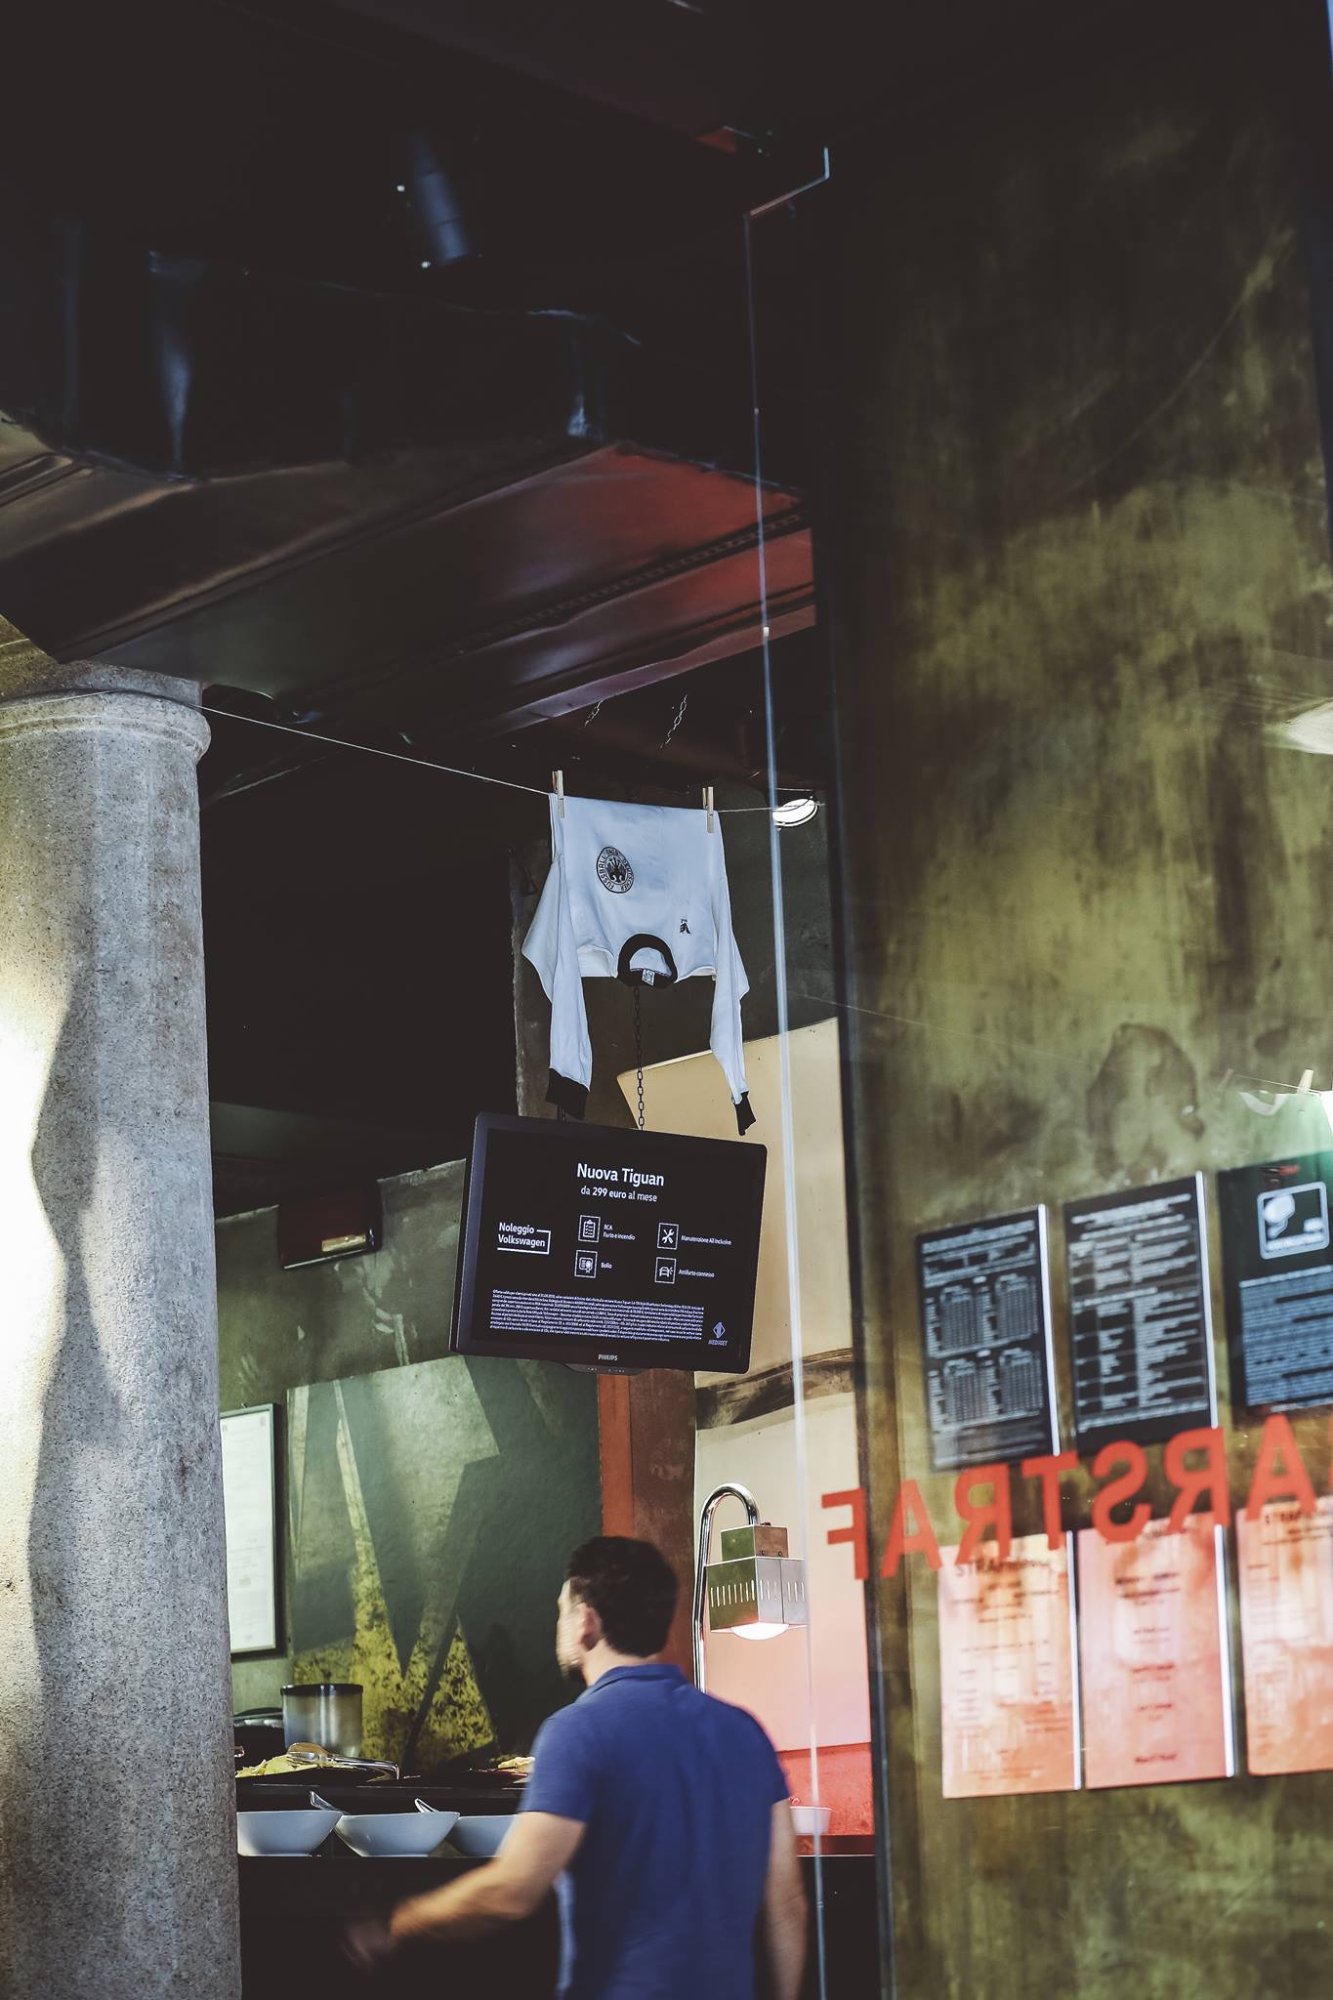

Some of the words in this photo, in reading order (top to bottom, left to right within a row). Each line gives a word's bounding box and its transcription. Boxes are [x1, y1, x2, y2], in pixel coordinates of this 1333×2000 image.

[576, 1163, 618, 1182] Nuova
[621, 1167, 665, 1187] Tiguan
[580, 1186, 591, 1196] da
[592, 1187, 608, 1198] 299
[609, 1190, 627, 1199] euro
[628, 1190, 636, 1200] al
[637, 1192, 658, 1202] mese
[498, 1221, 535, 1235] Noleggio
[497, 1233, 546, 1248] Volkswagen
